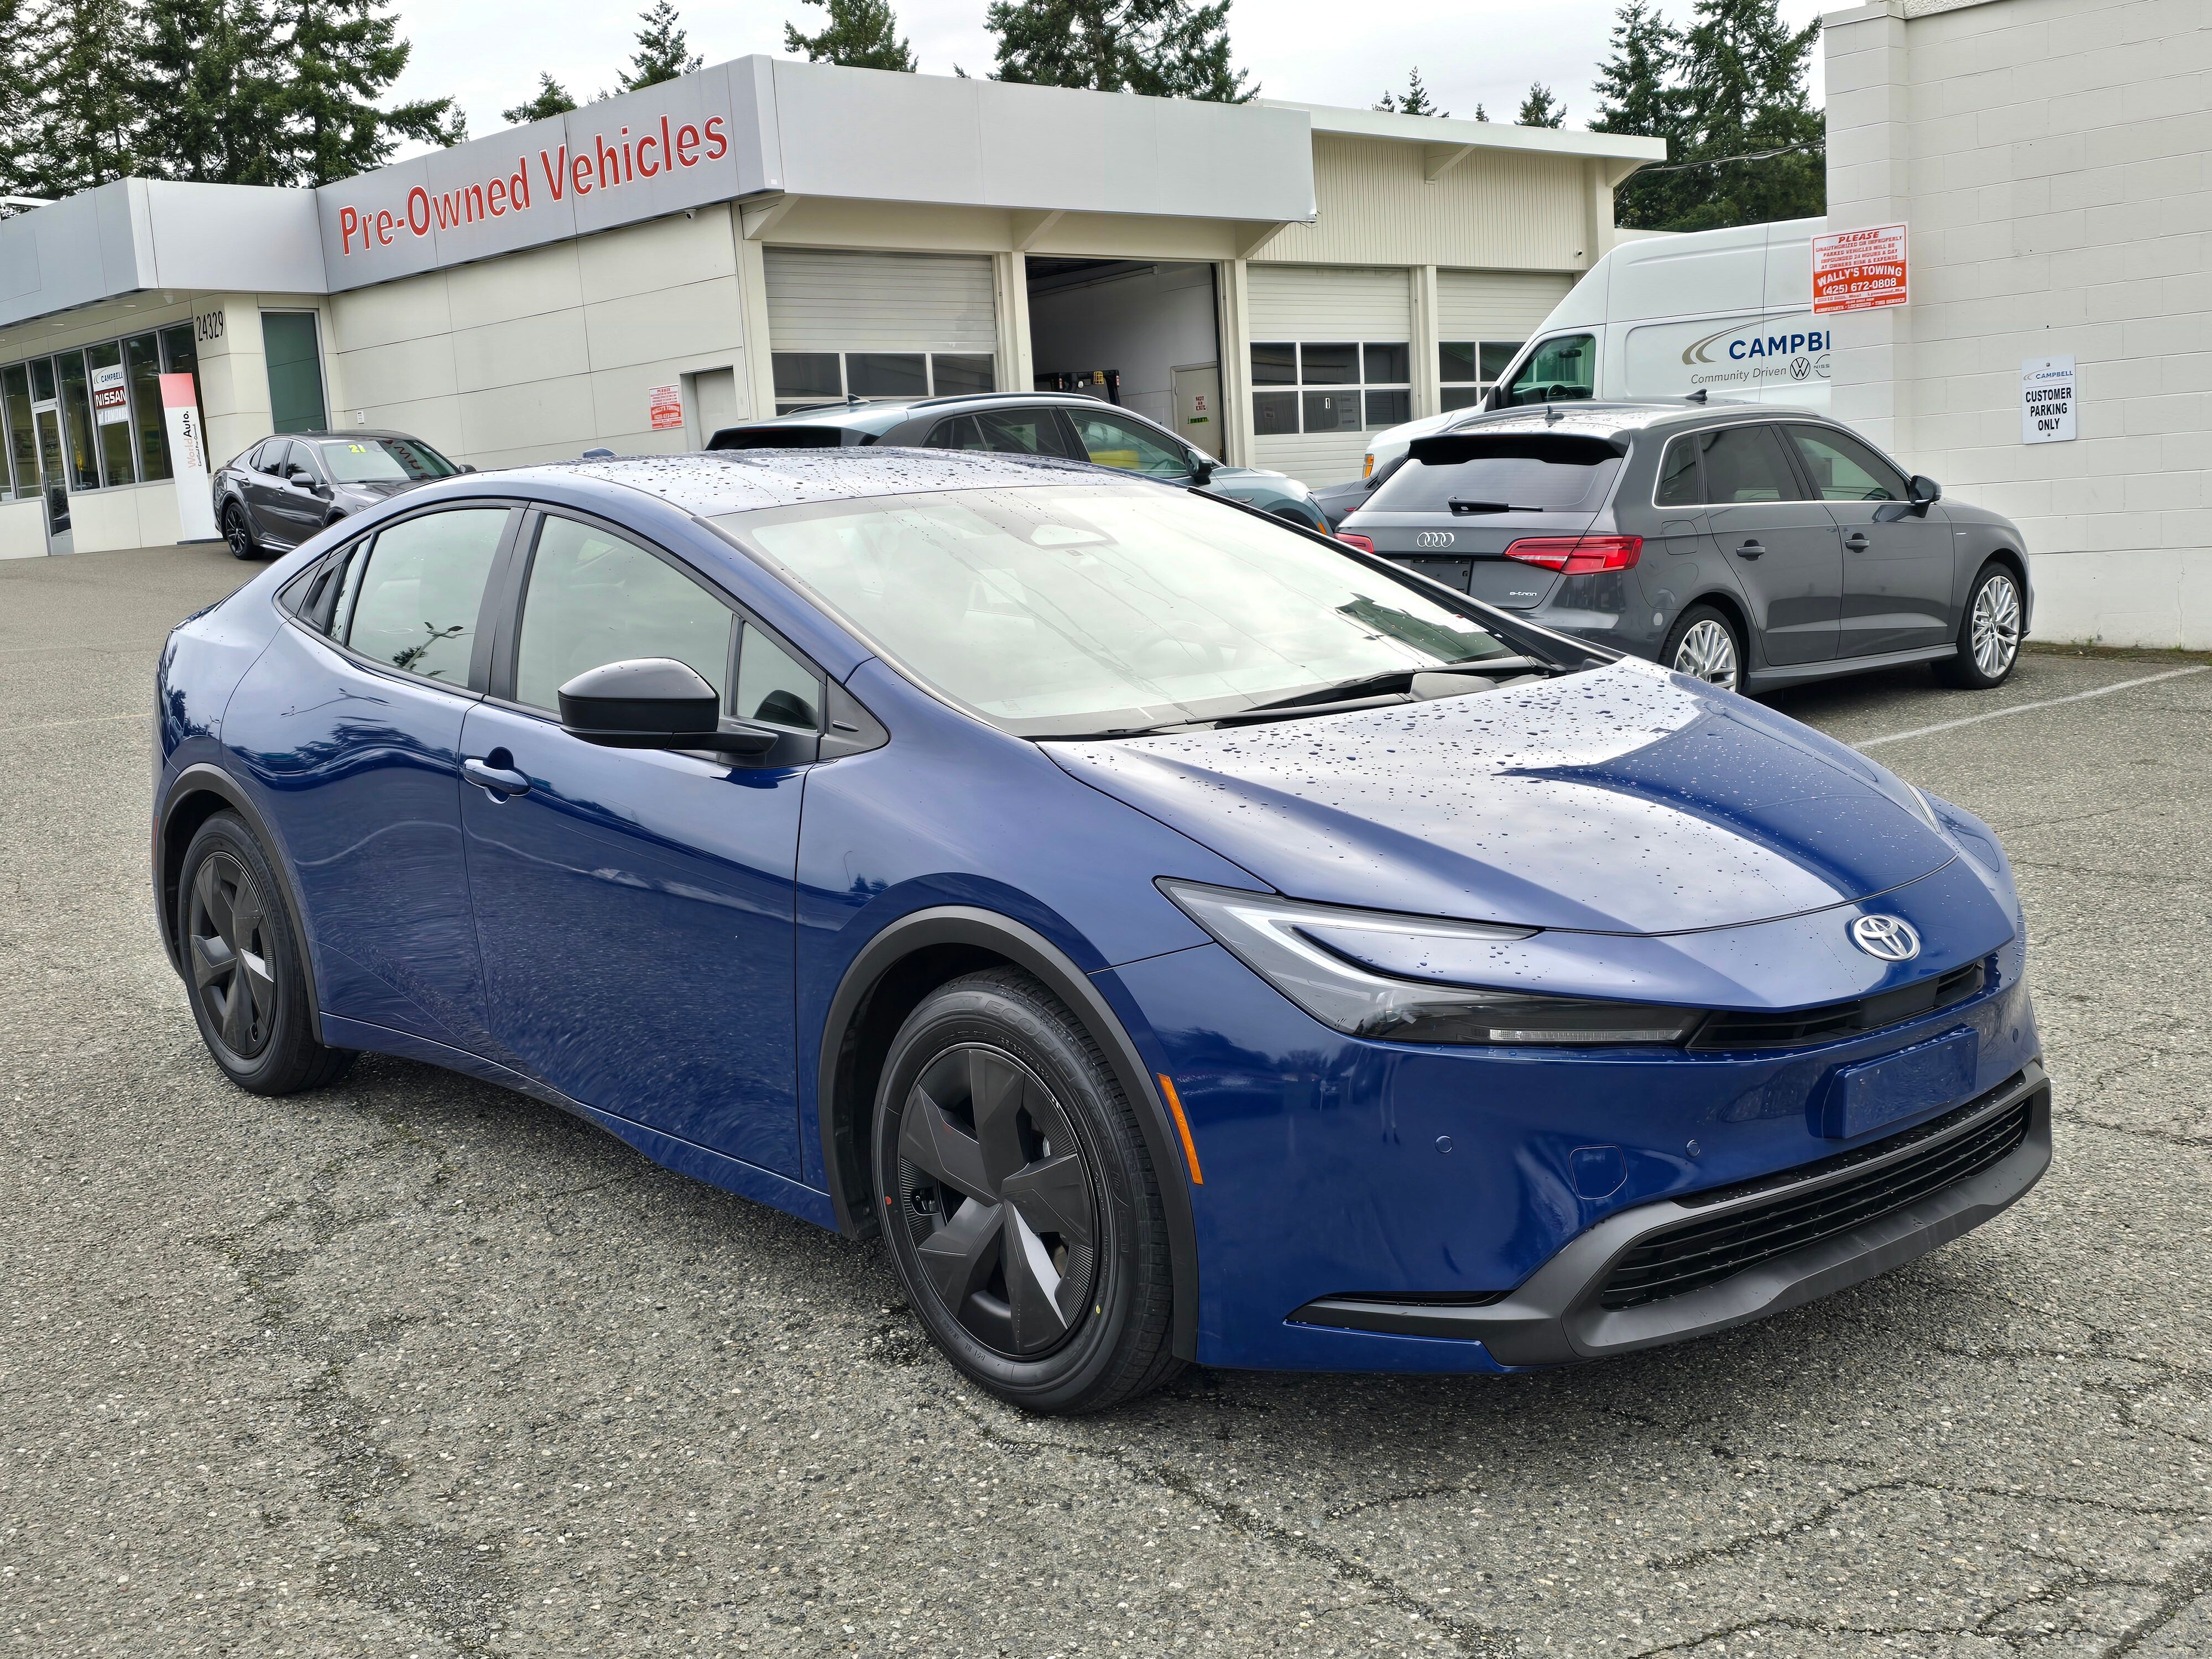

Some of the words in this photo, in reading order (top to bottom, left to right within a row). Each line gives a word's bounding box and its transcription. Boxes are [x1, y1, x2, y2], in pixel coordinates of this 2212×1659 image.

[338, 154, 533, 256] Pre-Owned
[539, 112, 729, 203] Vehicles
[1838, 231, 1880, 243] PLEASE
[1817, 268, 1860, 288] WALLY'S
[1862, 265, 1902, 276] TOWING
[1823, 284, 1848, 295] (425)
[1851, 278, 1897, 292] 672-0808
[196, 310, 224, 342] 24329
[101, 371, 123, 383] CAMPBELL
[1691, 370, 1750, 384] Community
[1753, 367, 1787, 378] Driven
[2036, 371, 2073, 379] CAMPBELL
[96, 389, 126, 406] NISSAN
[2026, 387, 2072, 403] CUSTOMER
[2031, 403, 2067, 416] PARKING
[2038, 418, 2060, 431] ONLY
[348, 444, 367, 453] 21
[984, 1000, 1078, 1082] ECOPIA
